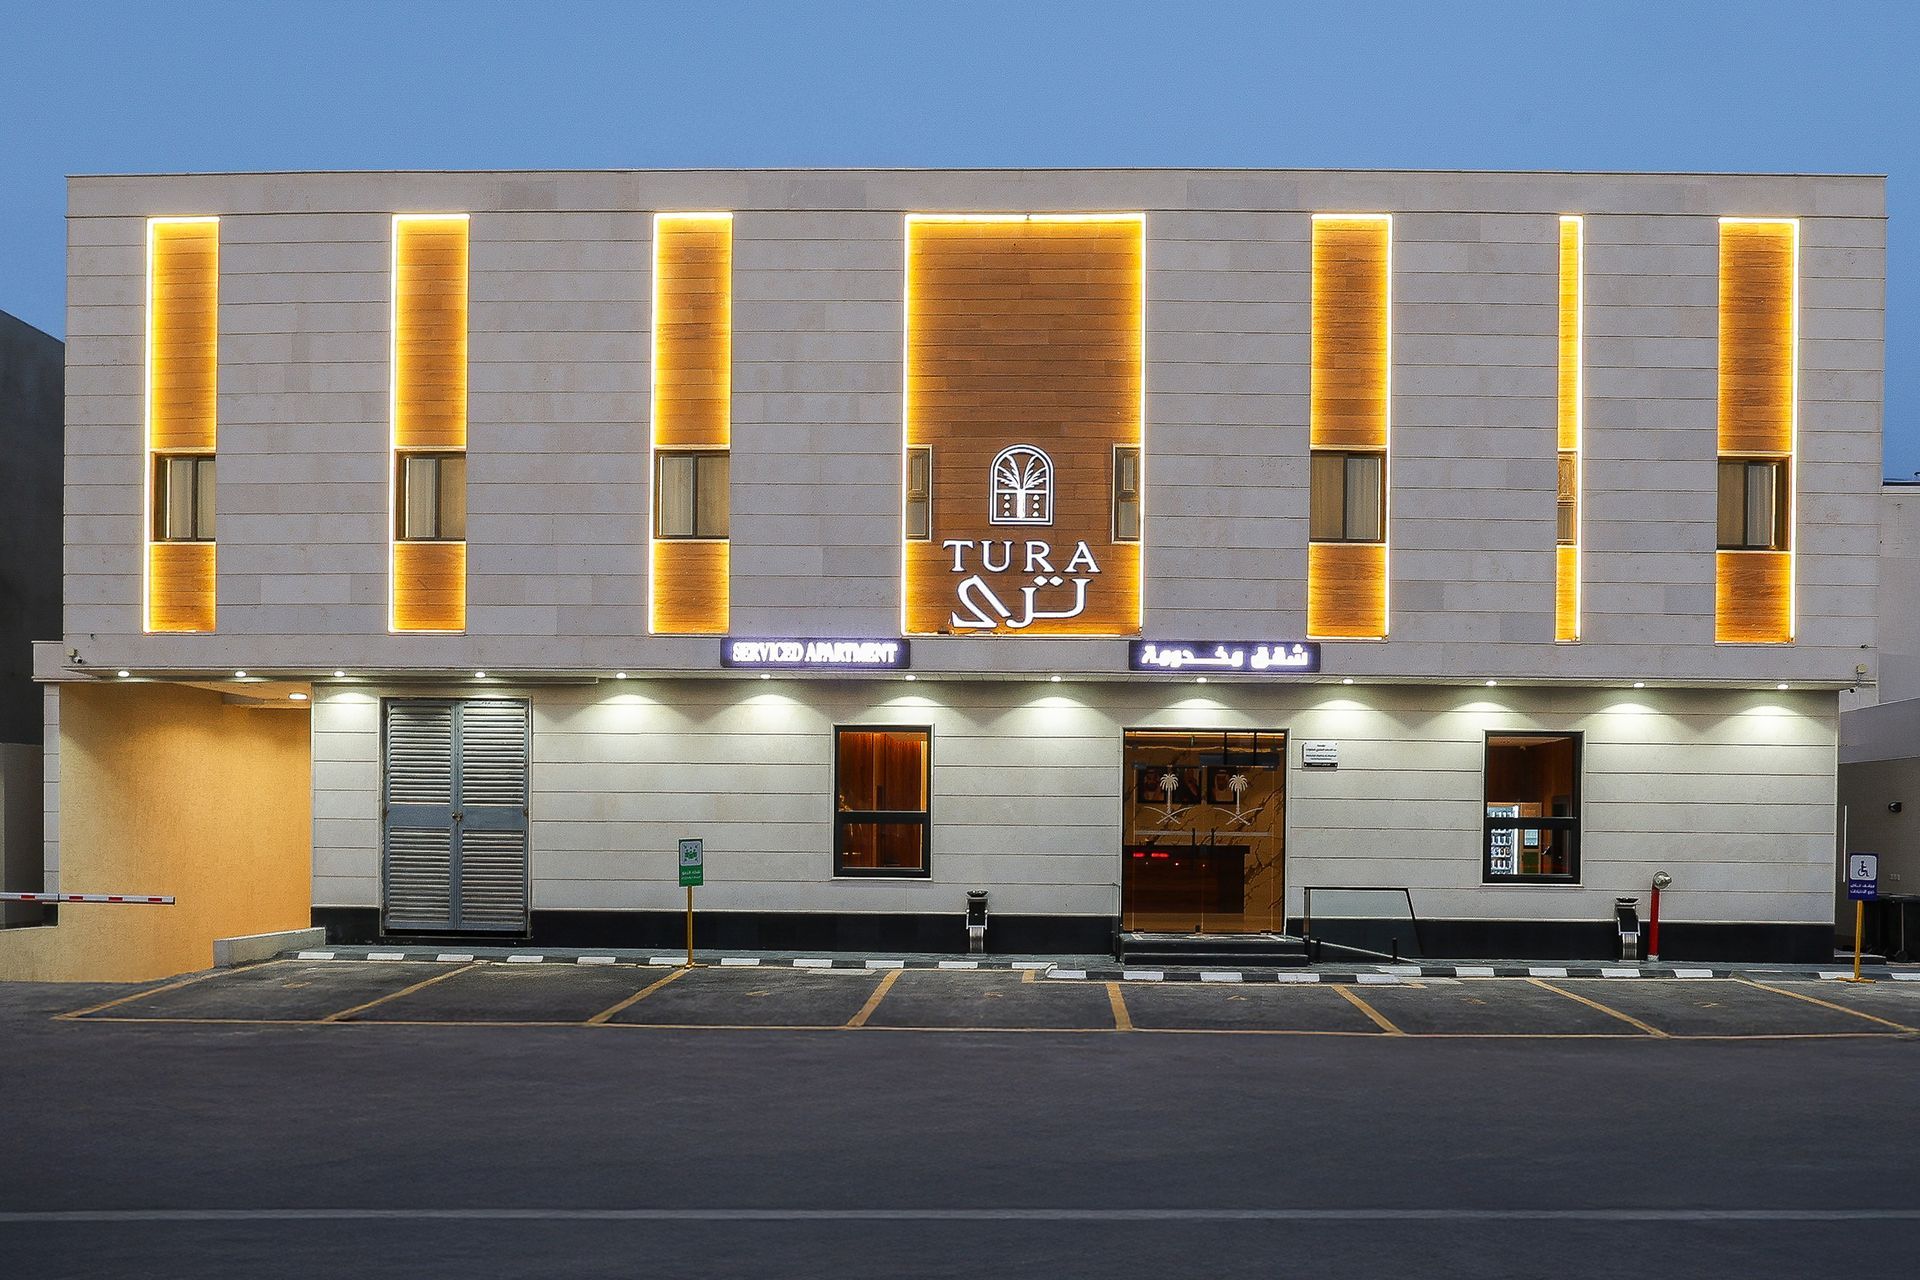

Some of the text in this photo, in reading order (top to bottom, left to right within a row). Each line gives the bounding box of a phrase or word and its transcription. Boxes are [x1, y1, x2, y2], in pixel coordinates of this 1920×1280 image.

[942, 540, 1101, 573] TURA
[732, 642, 898, 663] SERVICED APARTMENT
[1141, 643, 1308, 669] شقق مخدومة
